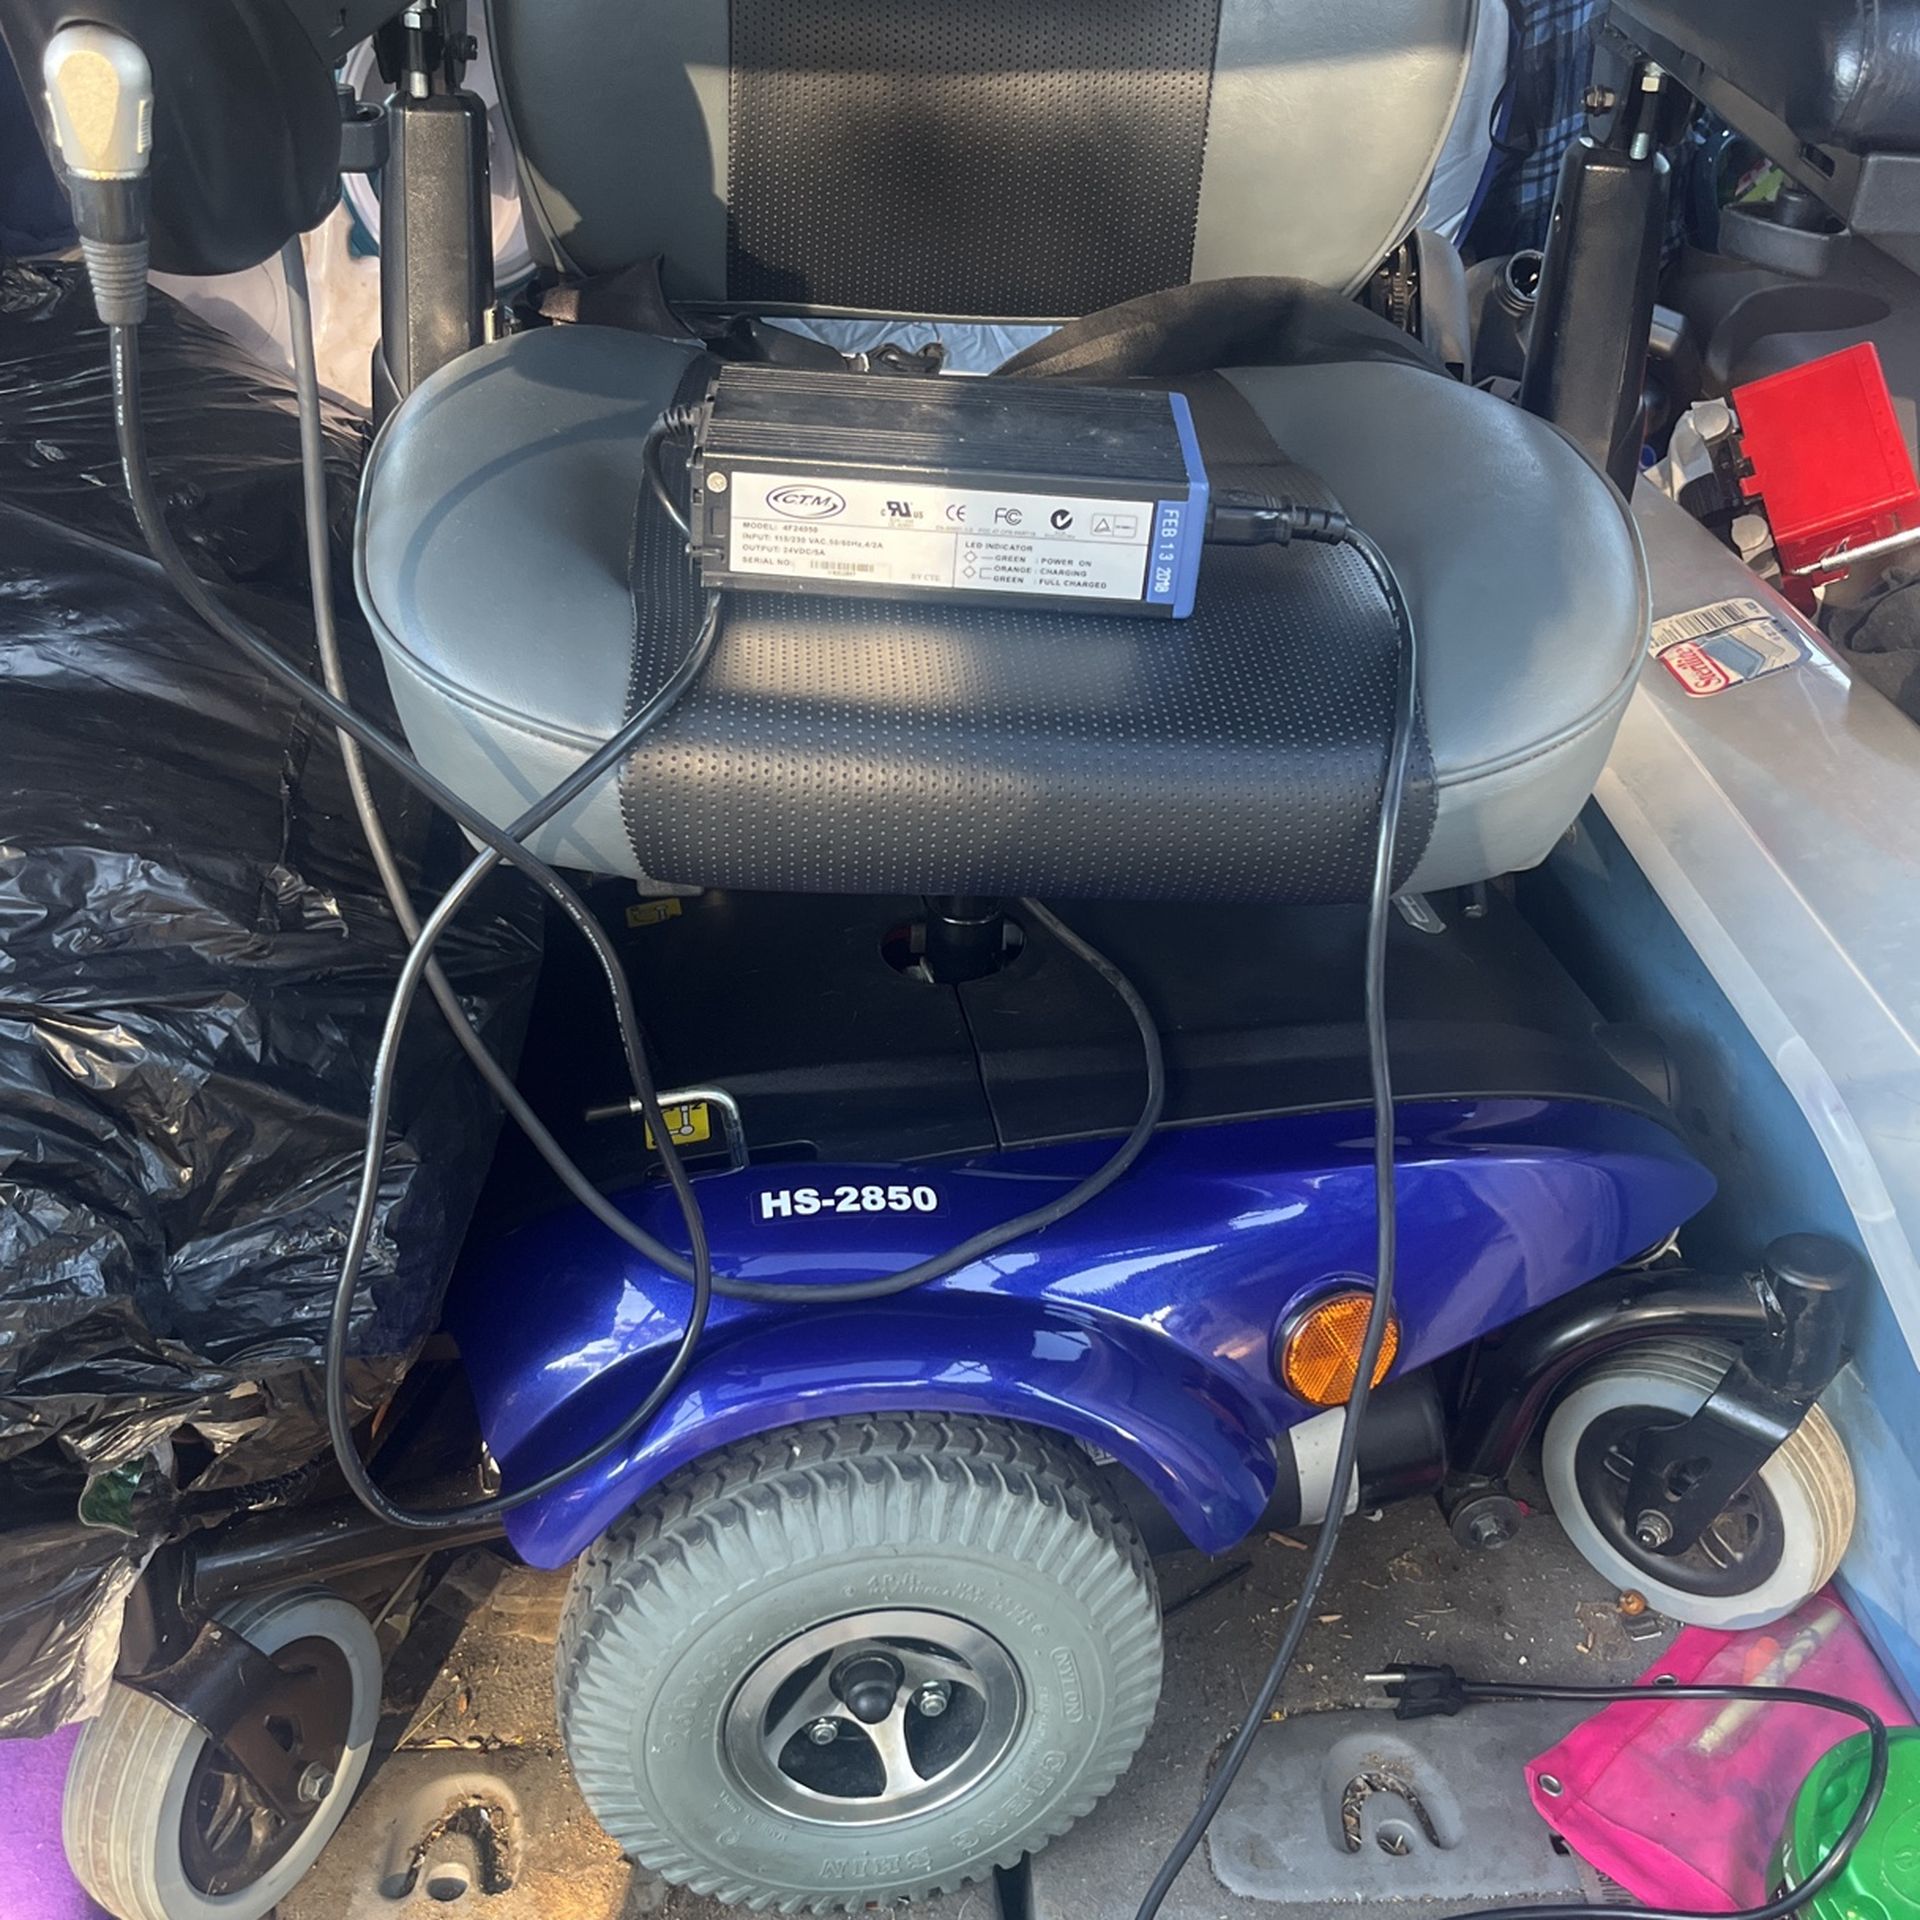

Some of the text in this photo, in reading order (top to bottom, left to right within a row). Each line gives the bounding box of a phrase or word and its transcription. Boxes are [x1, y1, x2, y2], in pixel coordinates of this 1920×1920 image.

[1161, 509, 1180, 538] FEB
[965, 541, 1033, 552] LED INDICATOR
[993, 564, 1087, 578] ORANGE CHARGING
[995, 554, 1026, 563] GREEN
[1041, 557, 1074, 567] POWER
[993, 575, 1107, 590] GREEN FULL CHARGED
[761, 1186, 938, 1219] HS-2850
[1055, 1652, 1082, 1716] NYLON
[818, 1848, 930, 1878] SHIN
